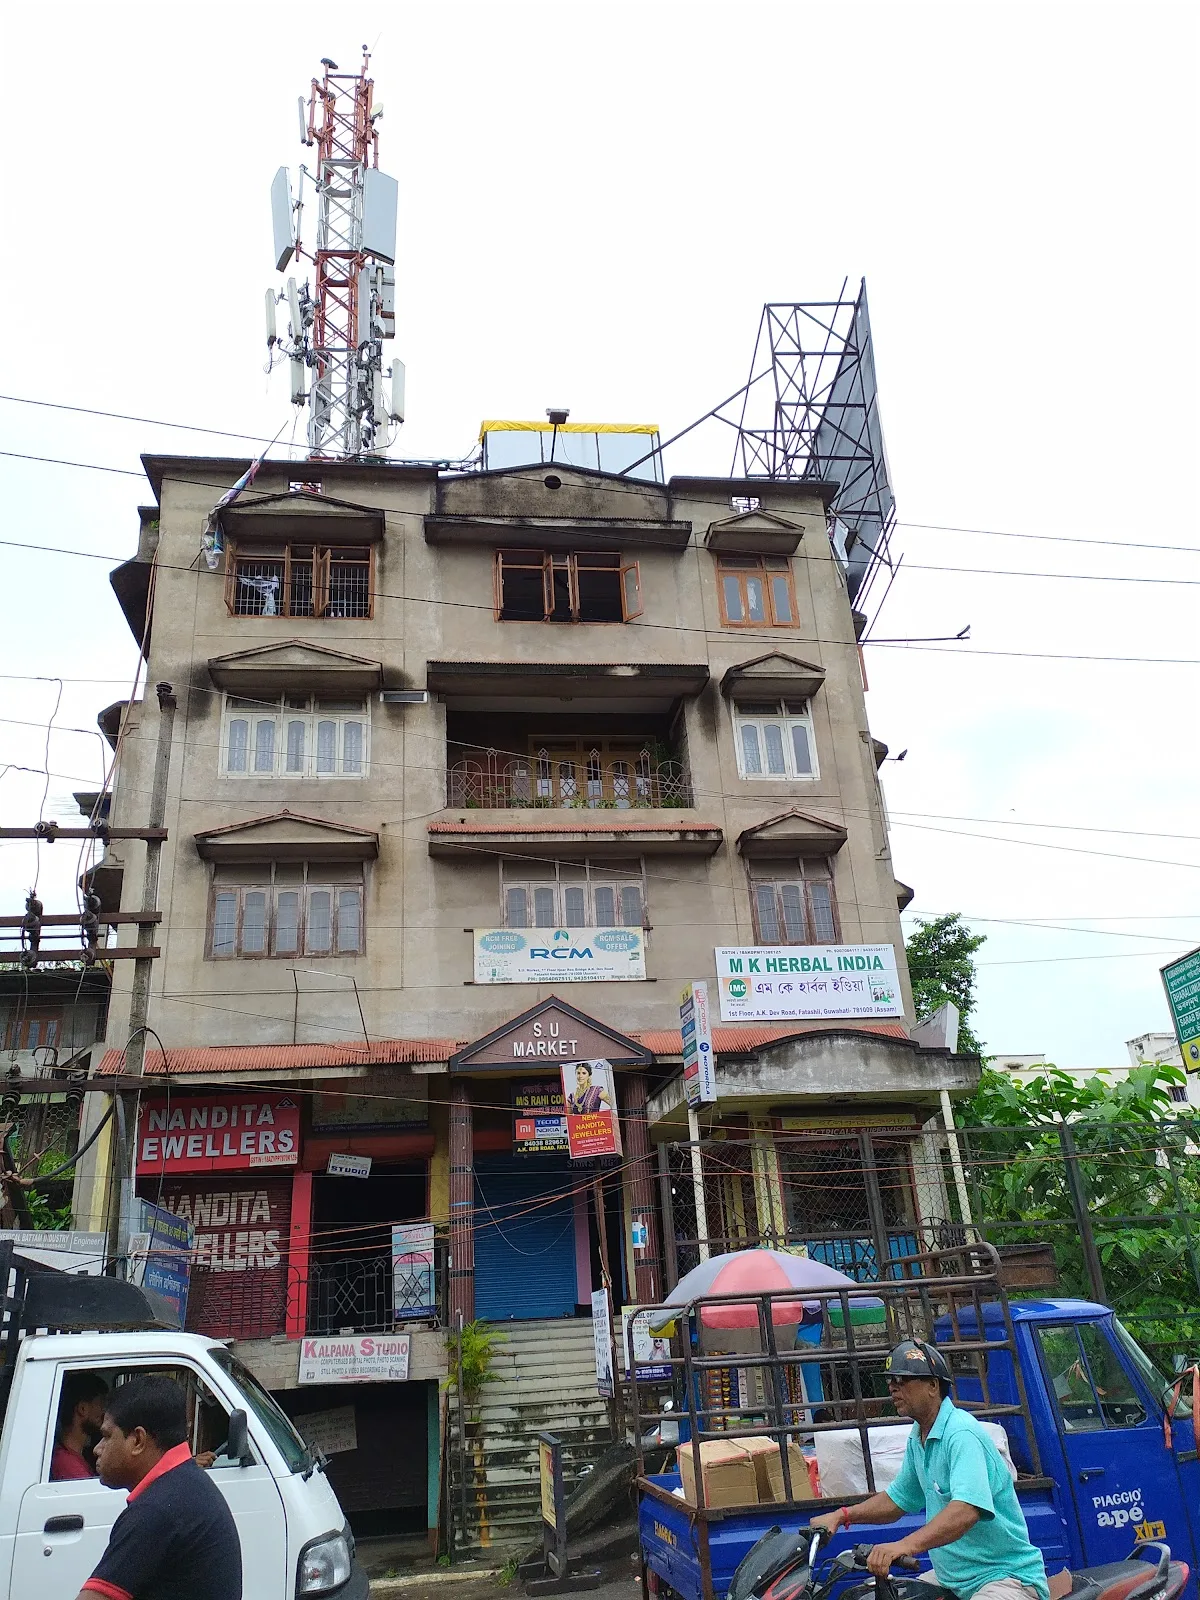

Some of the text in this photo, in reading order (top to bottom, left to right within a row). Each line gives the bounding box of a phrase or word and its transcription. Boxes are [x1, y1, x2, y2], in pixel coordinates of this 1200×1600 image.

[485, 935, 500, 943] RCM
[605, 942, 628, 950] OFFER
[530, 947, 594, 960] RCM
[729, 955, 884, 973] M K HERBAL INDIA
[729, 984, 747, 992] IMC
[755, 982, 773, 994] এম
[778, 982, 794, 994] কে
[874, 1006, 897, 1014] (Assam)
[513, 1039, 578, 1057] MARKET
[703, 1055, 711, 1095] MOTOROLA
[531, 1094, 549, 1106] RAHI
[148, 1104, 275, 1132] NANDITA
[575, 1121, 606, 1130] NANDITA
[571, 1128, 612, 1139] JEWELLERS
[141, 1129, 294, 1161] EWELLERS
[566, 1158, 614, 1168] SAMSNG
[331, 1165, 368, 1175] STUDIO
[22, 1233, 43, 1242] BATTAM
[43, 1233, 70, 1243] INDUSTRY
[191, 1230, 281, 1272] ELLERS
[304, 1338, 408, 1359] KALPANA STUDIO
[331, 1367, 344, 1375] PHOTO
[1092, 1489, 1142, 1508] PIAGGIO
[1096, 1502, 1144, 1528] apé
[1133, 1519, 1167, 1544] xtra
